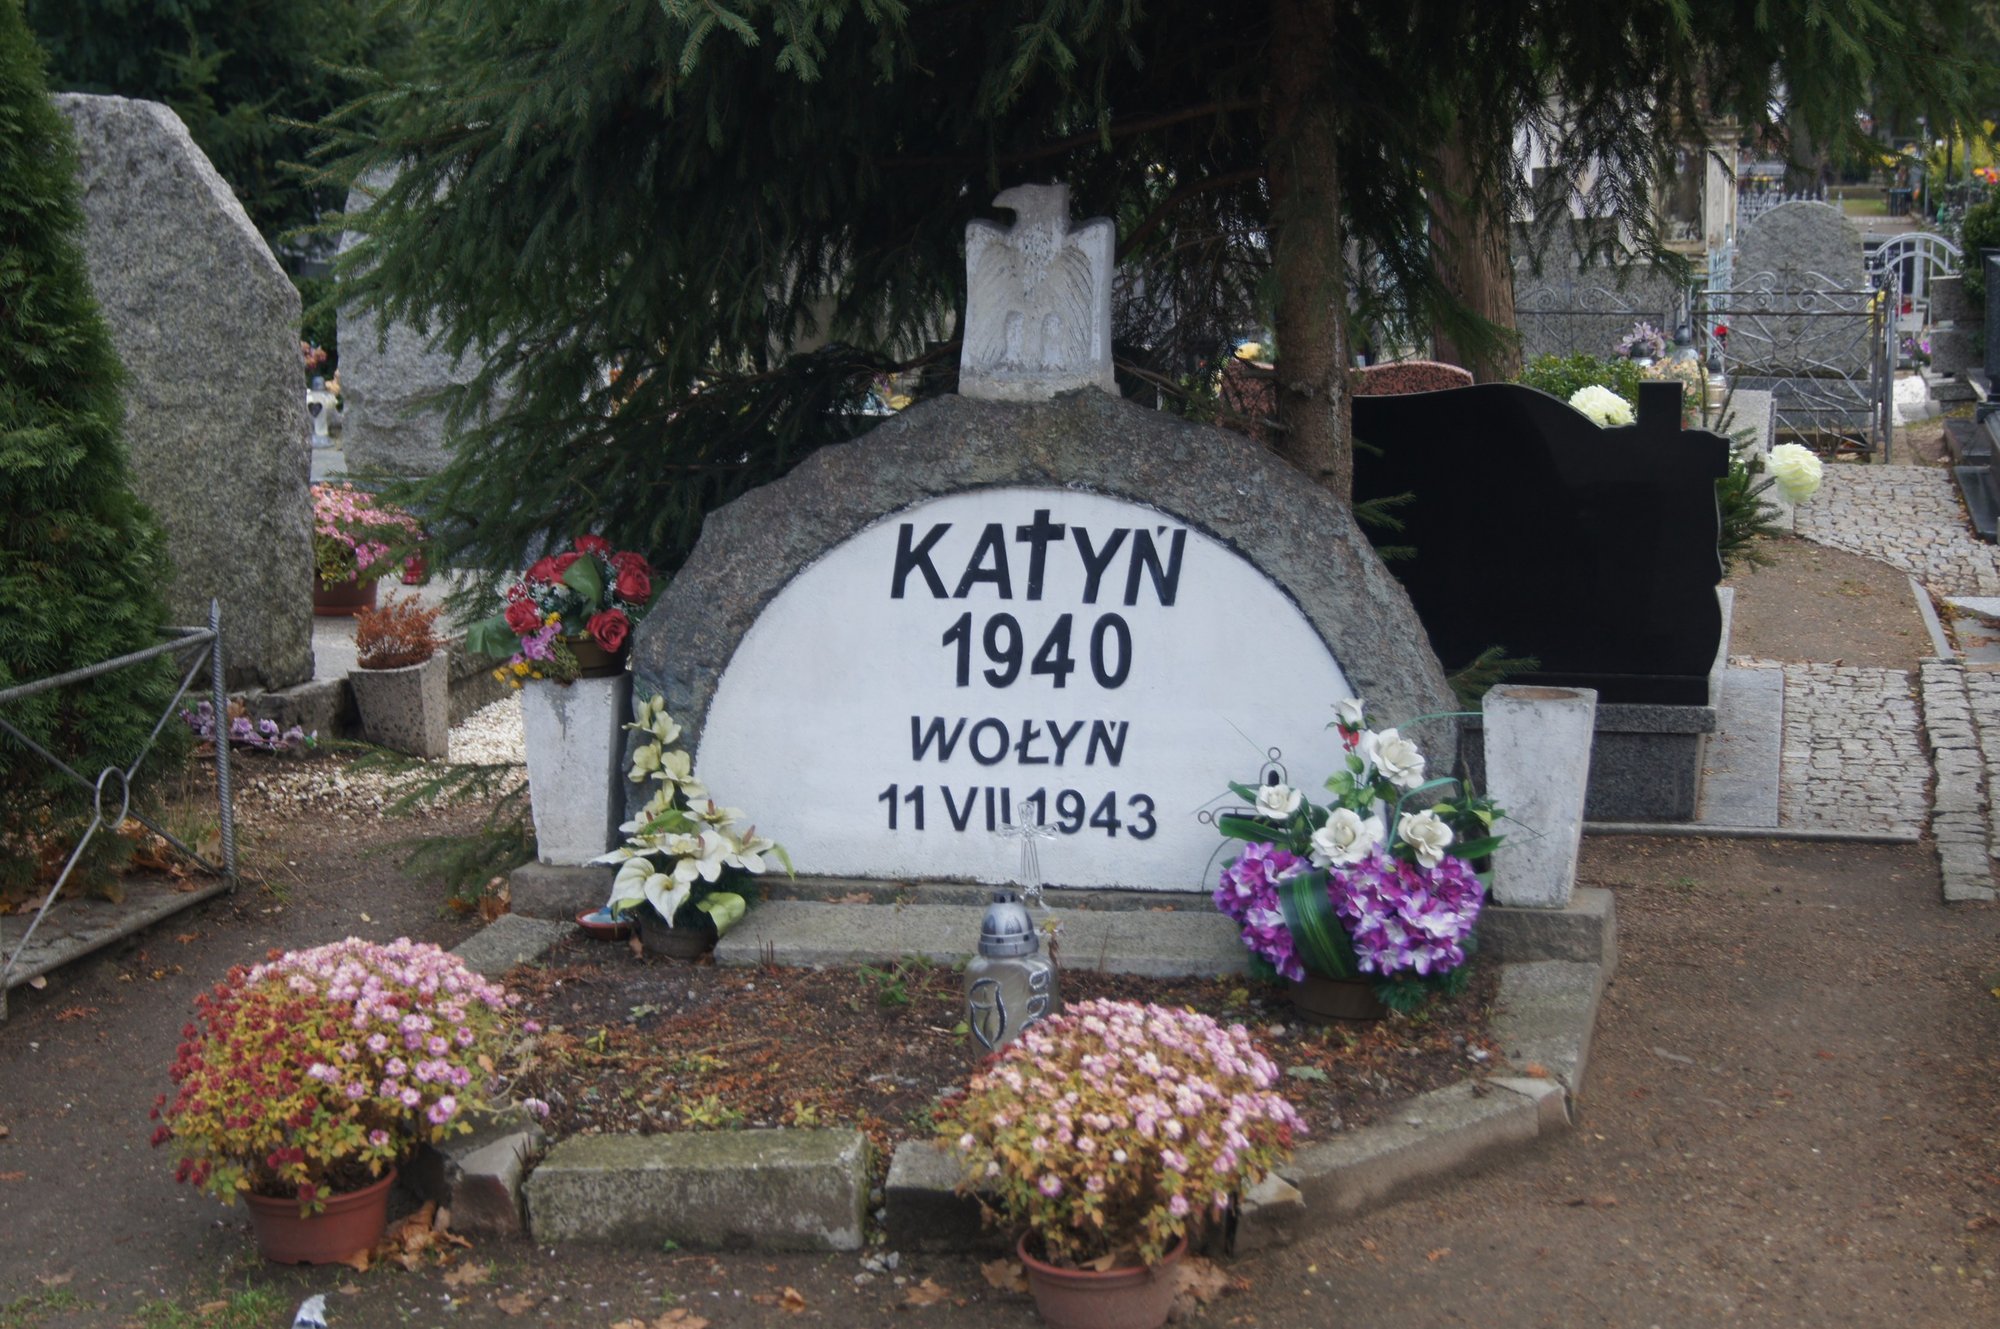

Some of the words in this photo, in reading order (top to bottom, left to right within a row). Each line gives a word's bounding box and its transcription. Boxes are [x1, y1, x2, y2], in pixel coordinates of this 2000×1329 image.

[890, 509, 1188, 607] KATYŃ
[942, 611, 1132, 690] 1940
[910, 715, 1130, 767] WOŁYŃ
[878, 783, 925, 831] 11
[939, 785, 1011, 832] VII
[1026, 786, 1157, 841] 1943
